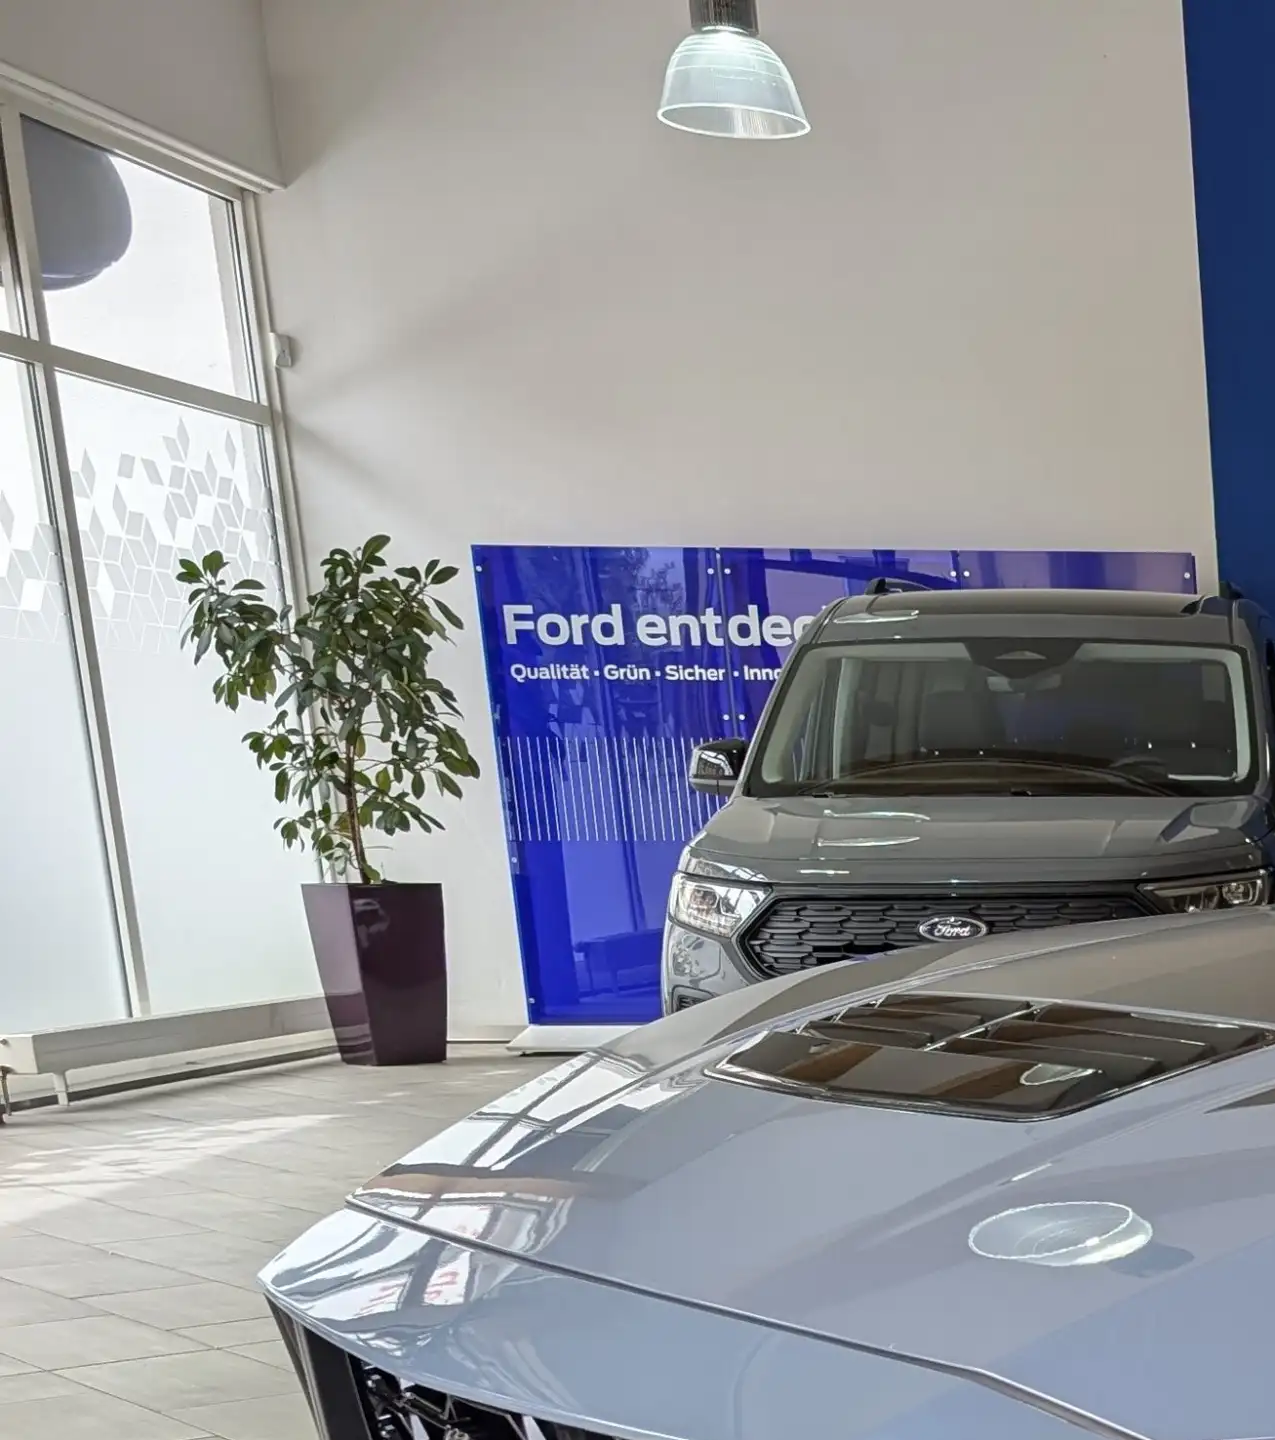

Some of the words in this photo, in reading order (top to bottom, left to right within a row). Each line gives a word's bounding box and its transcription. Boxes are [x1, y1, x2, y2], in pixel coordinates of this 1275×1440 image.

[502, 603, 625, 646] Ford
[510, 663, 590, 684] Qualität
[603, 663, 651, 682] Grün
[665, 664, 726, 682] Sicher
